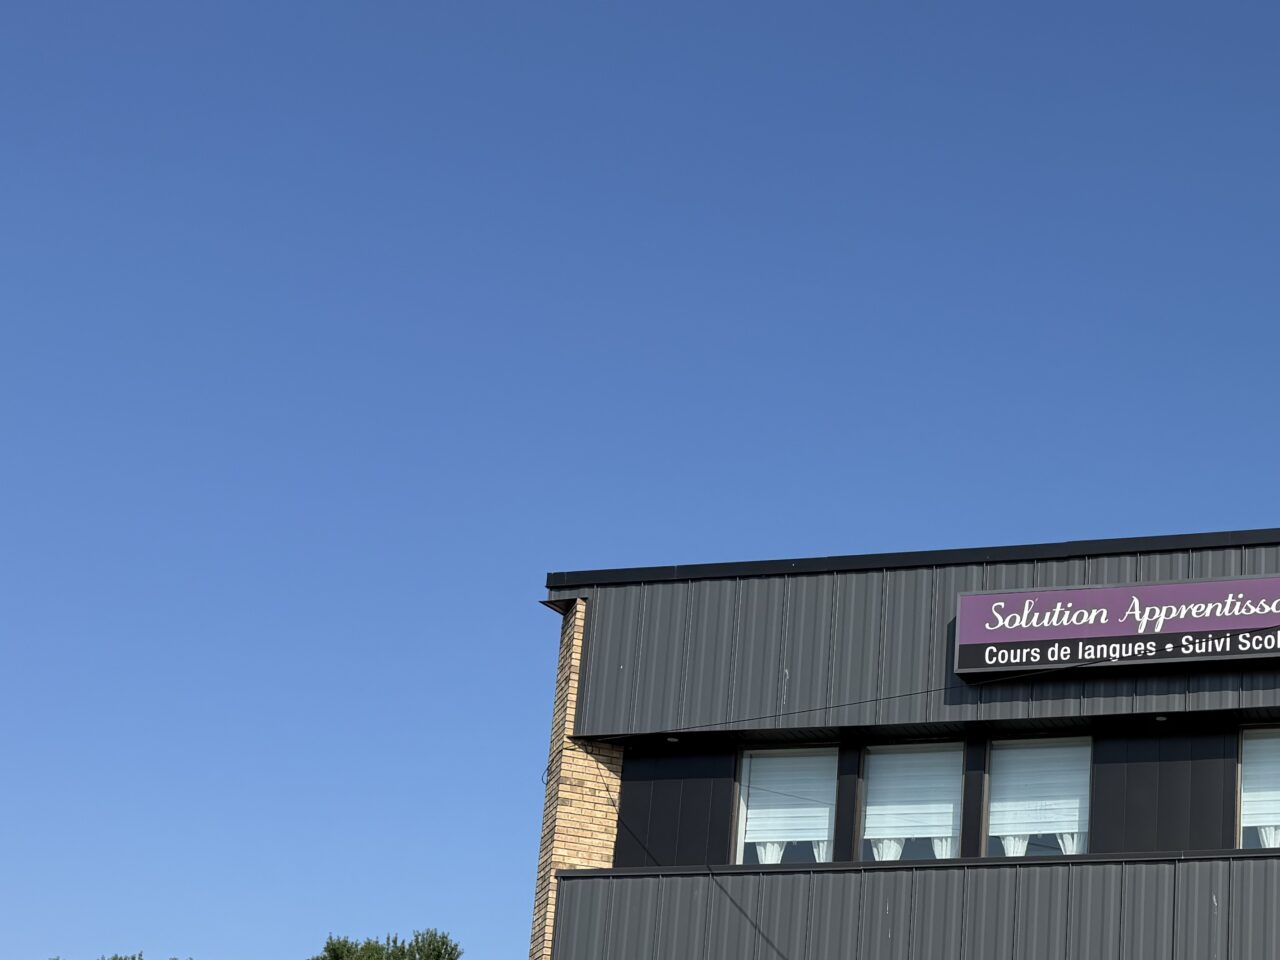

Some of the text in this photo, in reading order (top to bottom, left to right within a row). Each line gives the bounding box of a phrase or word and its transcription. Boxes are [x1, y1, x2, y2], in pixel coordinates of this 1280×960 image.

[985, 599, 1109, 630] Solution
[984, 646, 1040, 664] Cours
[1047, 643, 1071, 661] de
[1078, 641, 1156, 662] langues
[1181, 633, 1231, 654] Suivi
